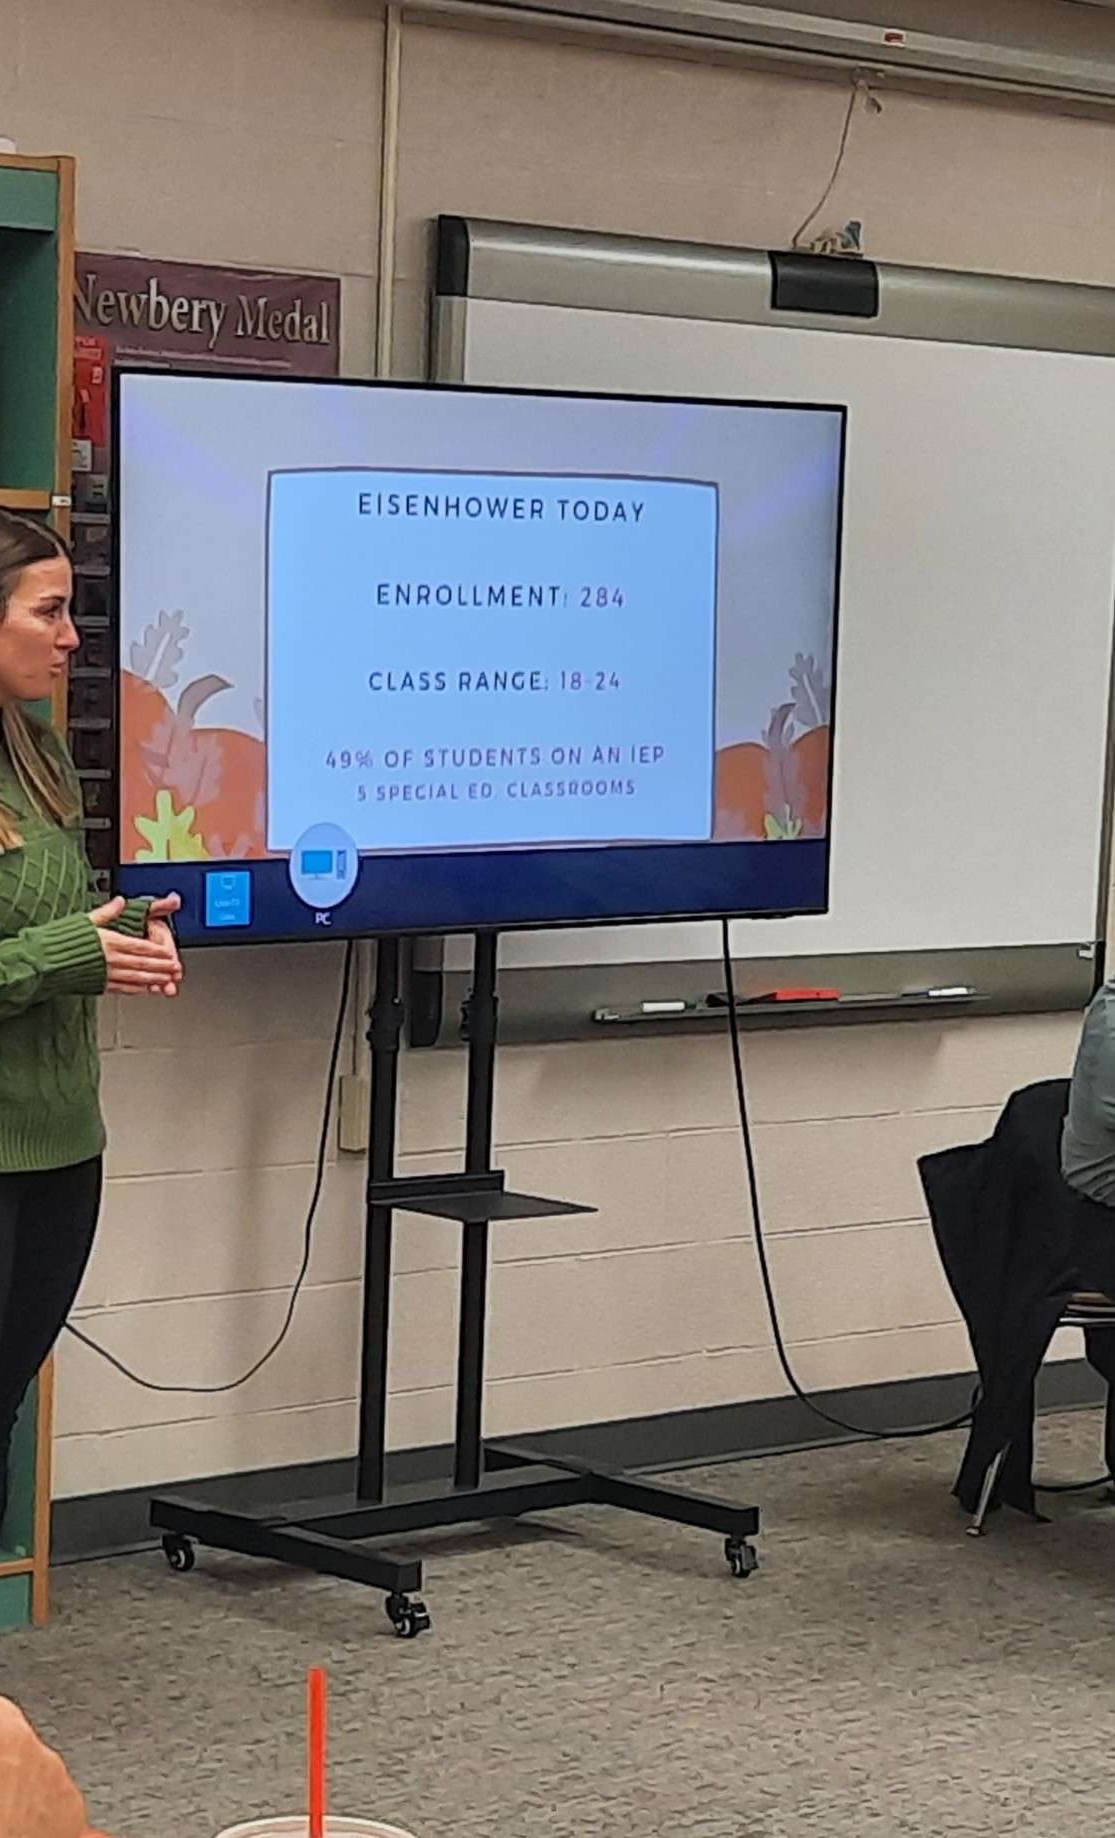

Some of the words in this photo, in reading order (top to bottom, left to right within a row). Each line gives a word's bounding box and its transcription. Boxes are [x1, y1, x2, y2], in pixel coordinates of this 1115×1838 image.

[73, 274, 227, 348] Newbery
[236, 294, 331, 344] Medal
[358, 492, 544, 520] EISENHOWER
[557, 499, 645, 522] TODAY
[376, 583, 568, 608] ENROLLMENT:
[580, 586, 624, 608] 284
[368, 671, 446, 691] CLASS
[458, 671, 550, 691] RANGE:
[325, 750, 374, 769] 49%
[384, 749, 414, 768] OF
[423, 746, 541, 768] STUDENTS
[551, 745, 582, 766] ON
[592, 745, 621, 764] AN
[631, 744, 664, 763] IEP
[357, 785, 366, 801] 5
[376, 783, 459, 801] SPECIAL
[468, 784, 493, 799] ED
[506, 781, 636, 799] CLASSROOMS
[315, 912, 332, 925] PC
